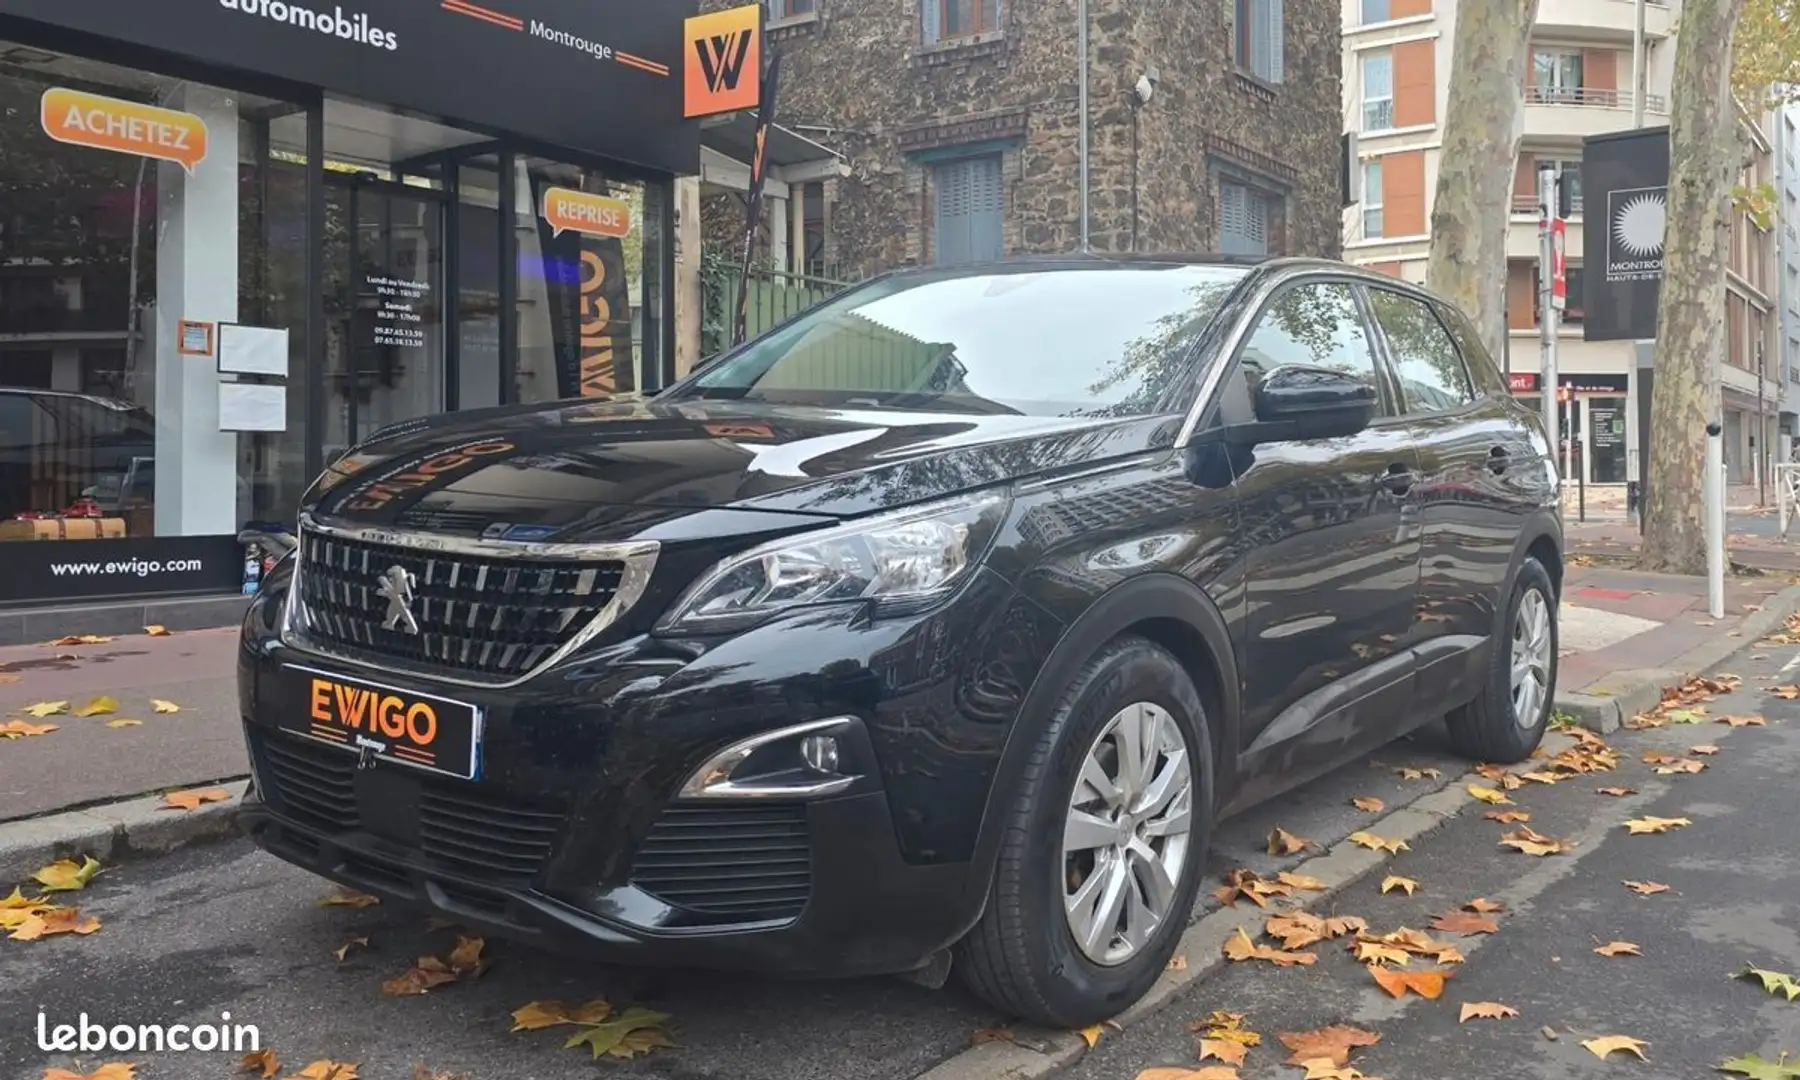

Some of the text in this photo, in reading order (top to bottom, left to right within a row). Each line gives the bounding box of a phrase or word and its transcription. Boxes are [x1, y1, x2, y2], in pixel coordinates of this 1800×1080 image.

[530, 19, 612, 60] Montrouge
[62, 104, 191, 151] ACHETEZ
[557, 198, 621, 229] REPRISE
[51, 557, 202, 578] www.ewigo.com
[311, 679, 437, 745] EWIGO
